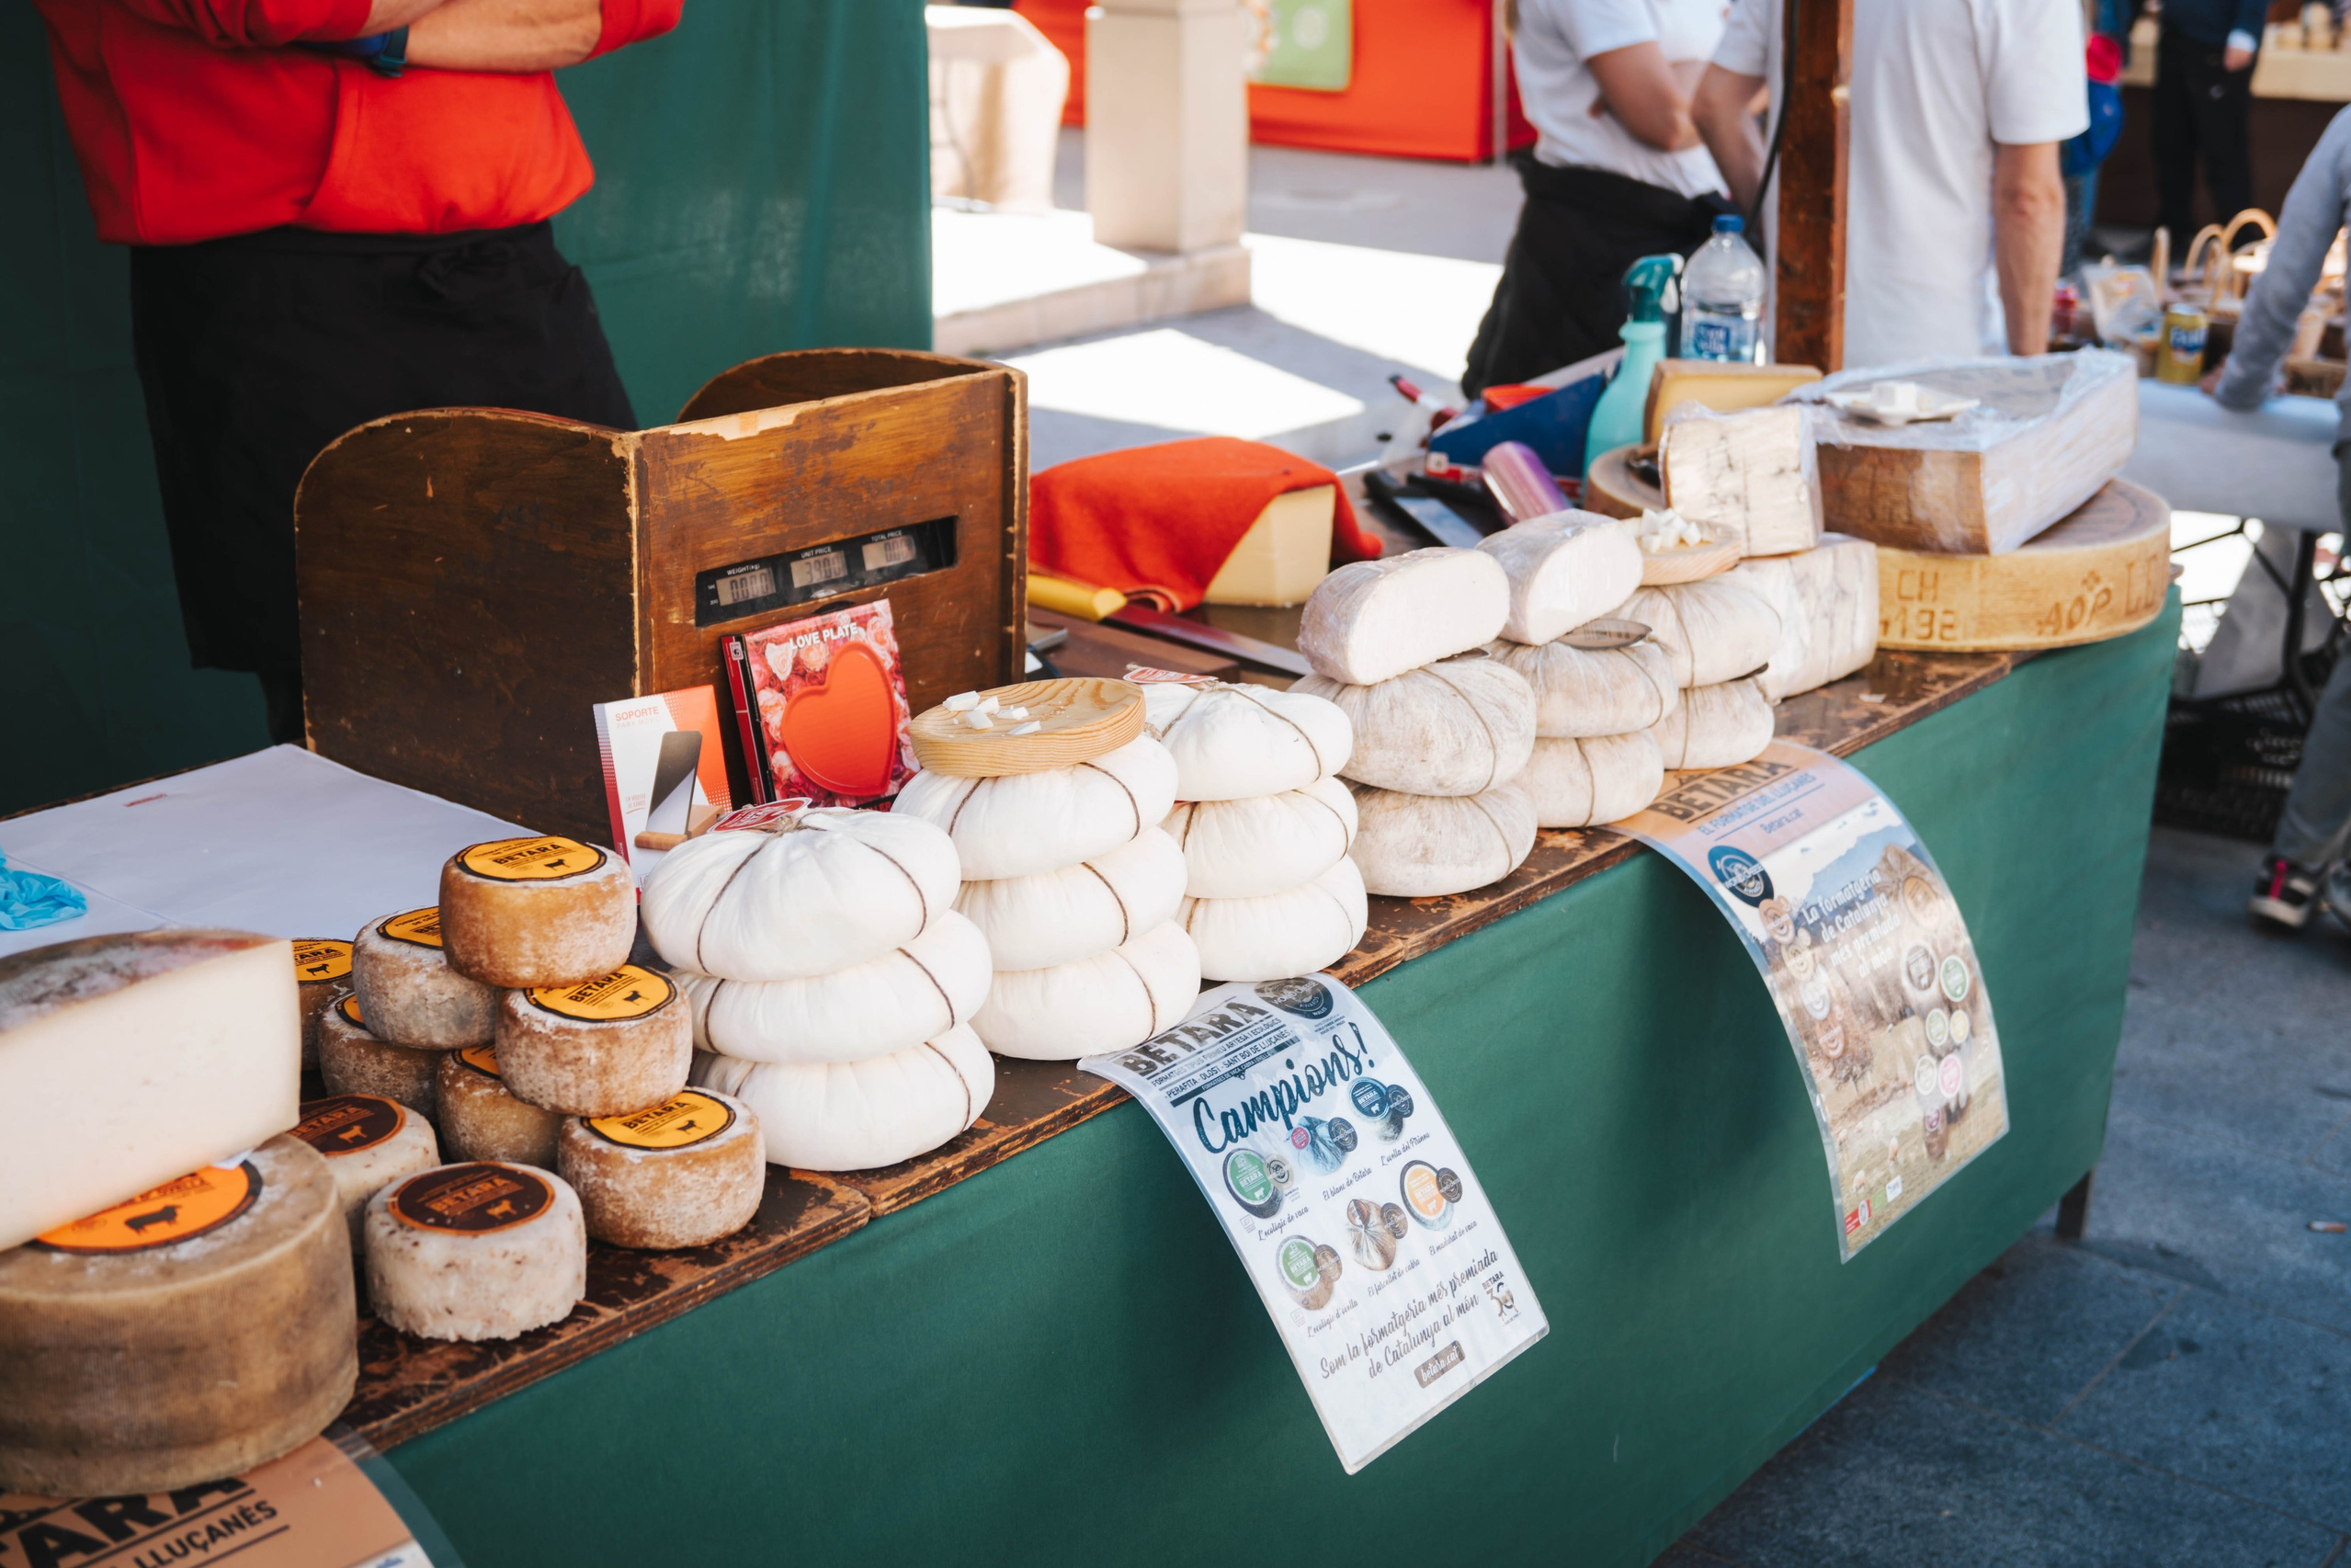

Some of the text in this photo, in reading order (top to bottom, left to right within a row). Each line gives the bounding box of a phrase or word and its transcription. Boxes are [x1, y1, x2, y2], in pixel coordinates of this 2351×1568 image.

[727, 562, 760, 576] WEIGHT(kg)
[801, 546, 832, 559] UNIT PRICE
[789, 622, 858, 651] LOVE PLATE
[615, 706, 660, 722] SOPORTE
[617, 720, 636, 729] PARA
[1647, 761, 1794, 821] BETARA
[1699, 824, 1716, 836] EL
[1754, 793, 1777, 808] DEL
[1759, 808, 1804, 834] Betara.cat
[492, 844, 562, 865] BETARA
[1801, 905, 1821, 925] La
[1820, 868, 1882, 915] formatgeria
[1821, 922, 1835, 944] de
[1834, 892, 1890, 936] Catalunya
[1830, 942, 1853, 968] més
[1852, 913, 1902, 957] premiada
[1857, 957, 1871, 979] al
[1869, 945, 1895, 970] món
[567, 971, 628, 1003] BETARA
[1312, 1007, 1327, 1017] WALES
[1112, 1002, 1269, 1076] BETARA
[1152, 1064, 1187, 1086] FORMATGES
[1166, 1029, 1291, 1098] PERAFITA OLOST SANT BOI DE LLUÇANÈS
[1193, 1021, 1374, 1153] Campions!
[1357, 1091, 1379, 1104] BETARA
[621, 1102, 689, 1130] BETARA
[1380, 1148, 1402, 1166] L'ovella
[1402, 1141, 1411, 1153] del
[428, 1177, 512, 1211] BETARA
[1239, 1171, 1263, 1187] BETARA
[1323, 1167, 1372, 1201] El blanc de Betara
[1287, 1213, 1295, 1223] de
[1294, 1206, 1310, 1219] vaca
[1429, 1221, 1478, 1256] El madurat de vaca
[1289, 1256, 1312, 1272] BETARA
[1368, 1258, 1421, 1297] El farcellet de cabra
[1482, 1270, 1505, 1290] BETARA
[1320, 1248, 1499, 1379] Som la formatgeria més premiada
[1369, 1359, 1383, 1380] de
[1383, 1320, 1442, 1368] Catalunya
[1442, 1304, 1455, 1327] al
[1456, 1293, 1480, 1319] món
[1420, 1345, 1459, 1382] betara.cat
[132, 1498, 278, 1568] LLUÇANÈS
